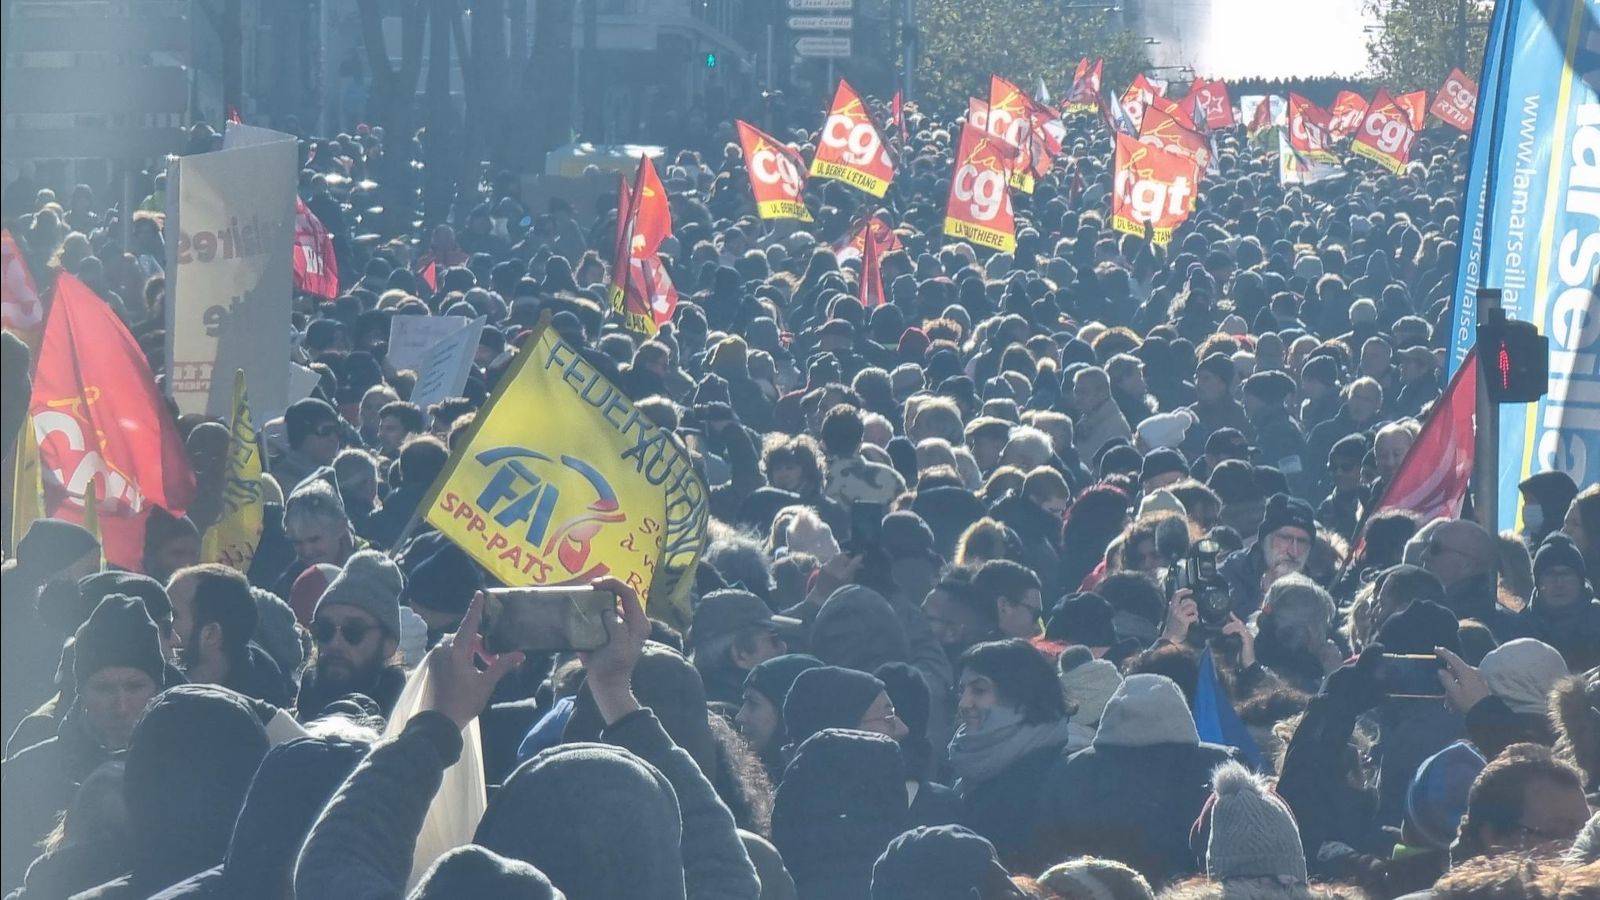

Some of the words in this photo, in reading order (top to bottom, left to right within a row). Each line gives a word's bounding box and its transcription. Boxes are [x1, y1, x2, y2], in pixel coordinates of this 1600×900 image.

[821, 114, 893, 168] cg
[751, 149, 804, 198] cg
[954, 164, 1014, 221] cg
[476, 459, 560, 548] FA
[439, 491, 555, 585] SPP-PATS
